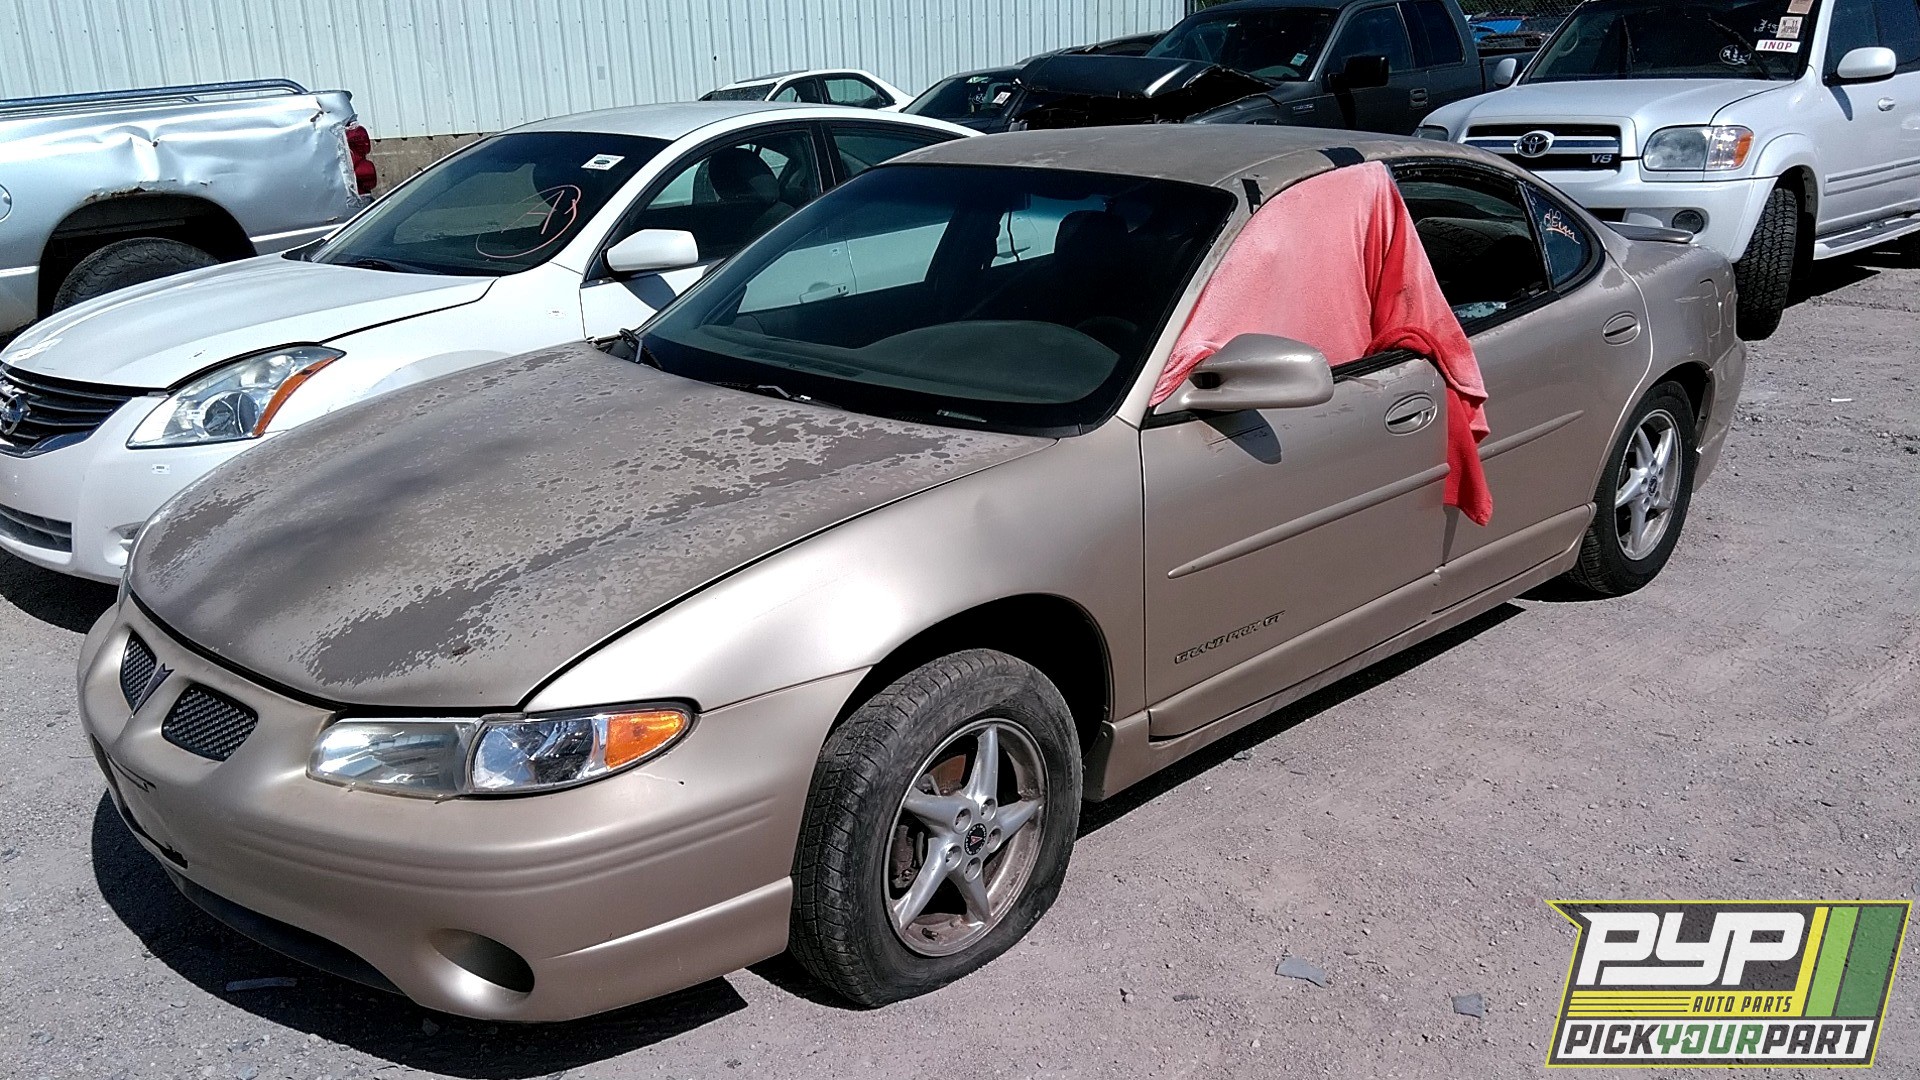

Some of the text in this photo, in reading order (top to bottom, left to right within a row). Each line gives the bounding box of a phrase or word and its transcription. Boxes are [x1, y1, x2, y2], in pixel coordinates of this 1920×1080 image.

[1763, 41, 1793, 50] INOP
[1591, 154, 1612, 164] V8
[1174, 635, 1226, 665] GRAND
[1263, 609, 1287, 627] GT
